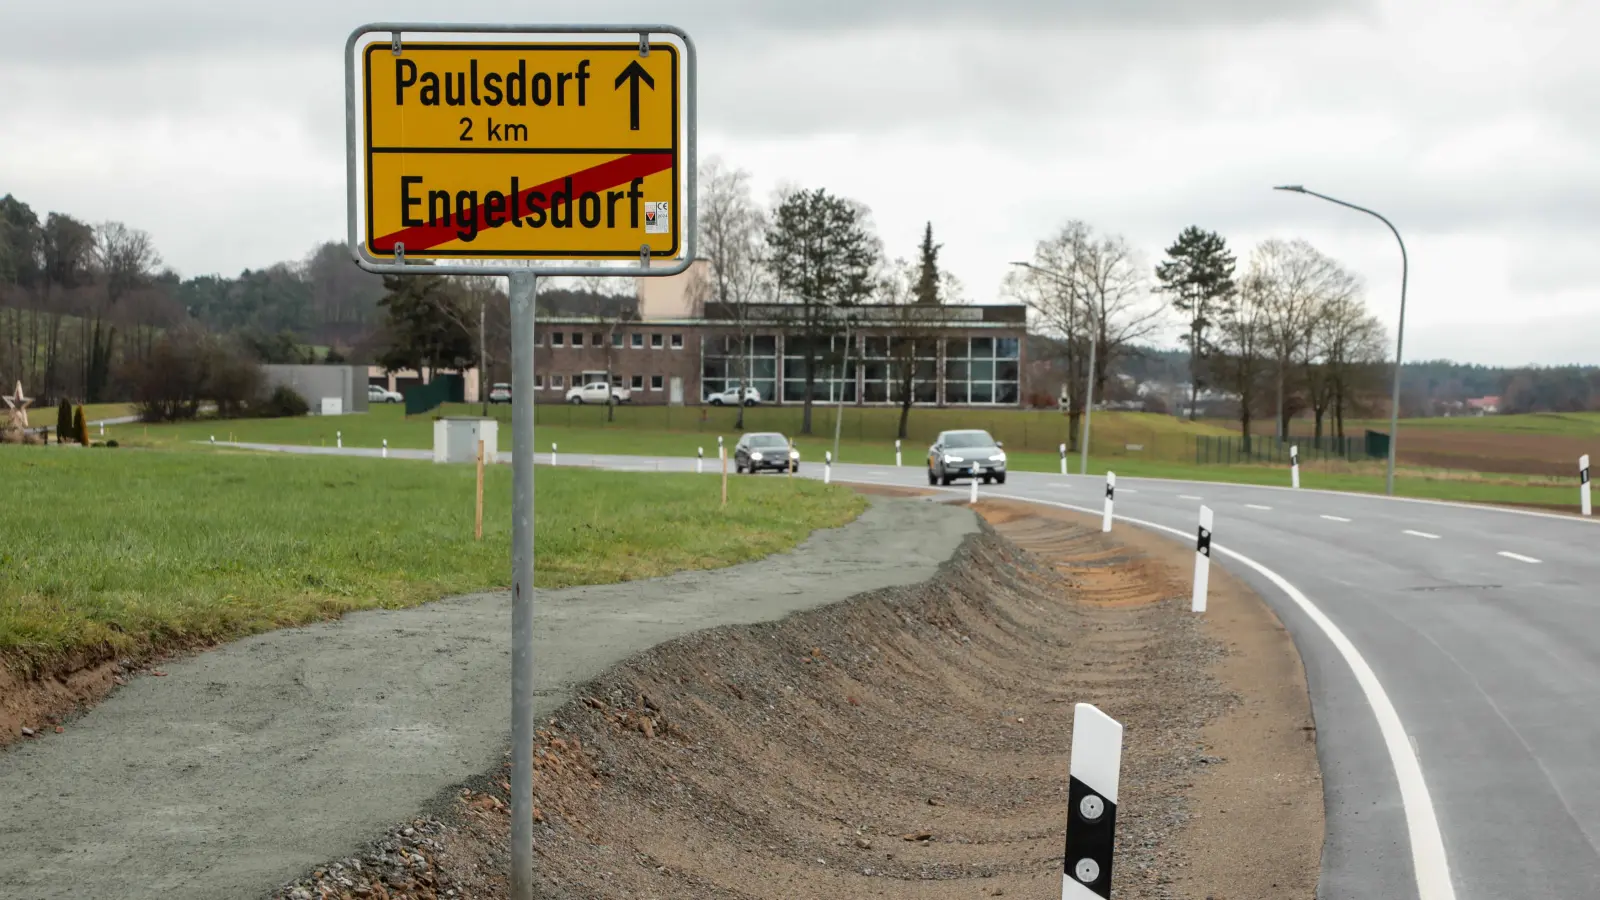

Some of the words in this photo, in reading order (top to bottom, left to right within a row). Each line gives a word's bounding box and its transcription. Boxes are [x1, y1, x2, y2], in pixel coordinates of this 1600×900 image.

[395, 59, 590, 106] Paulsdorf
[459, 117, 473, 141] 2
[487, 117, 528, 141] km
[401, 176, 644, 242] Engelsdorf
[657, 202, 668, 210] CE
